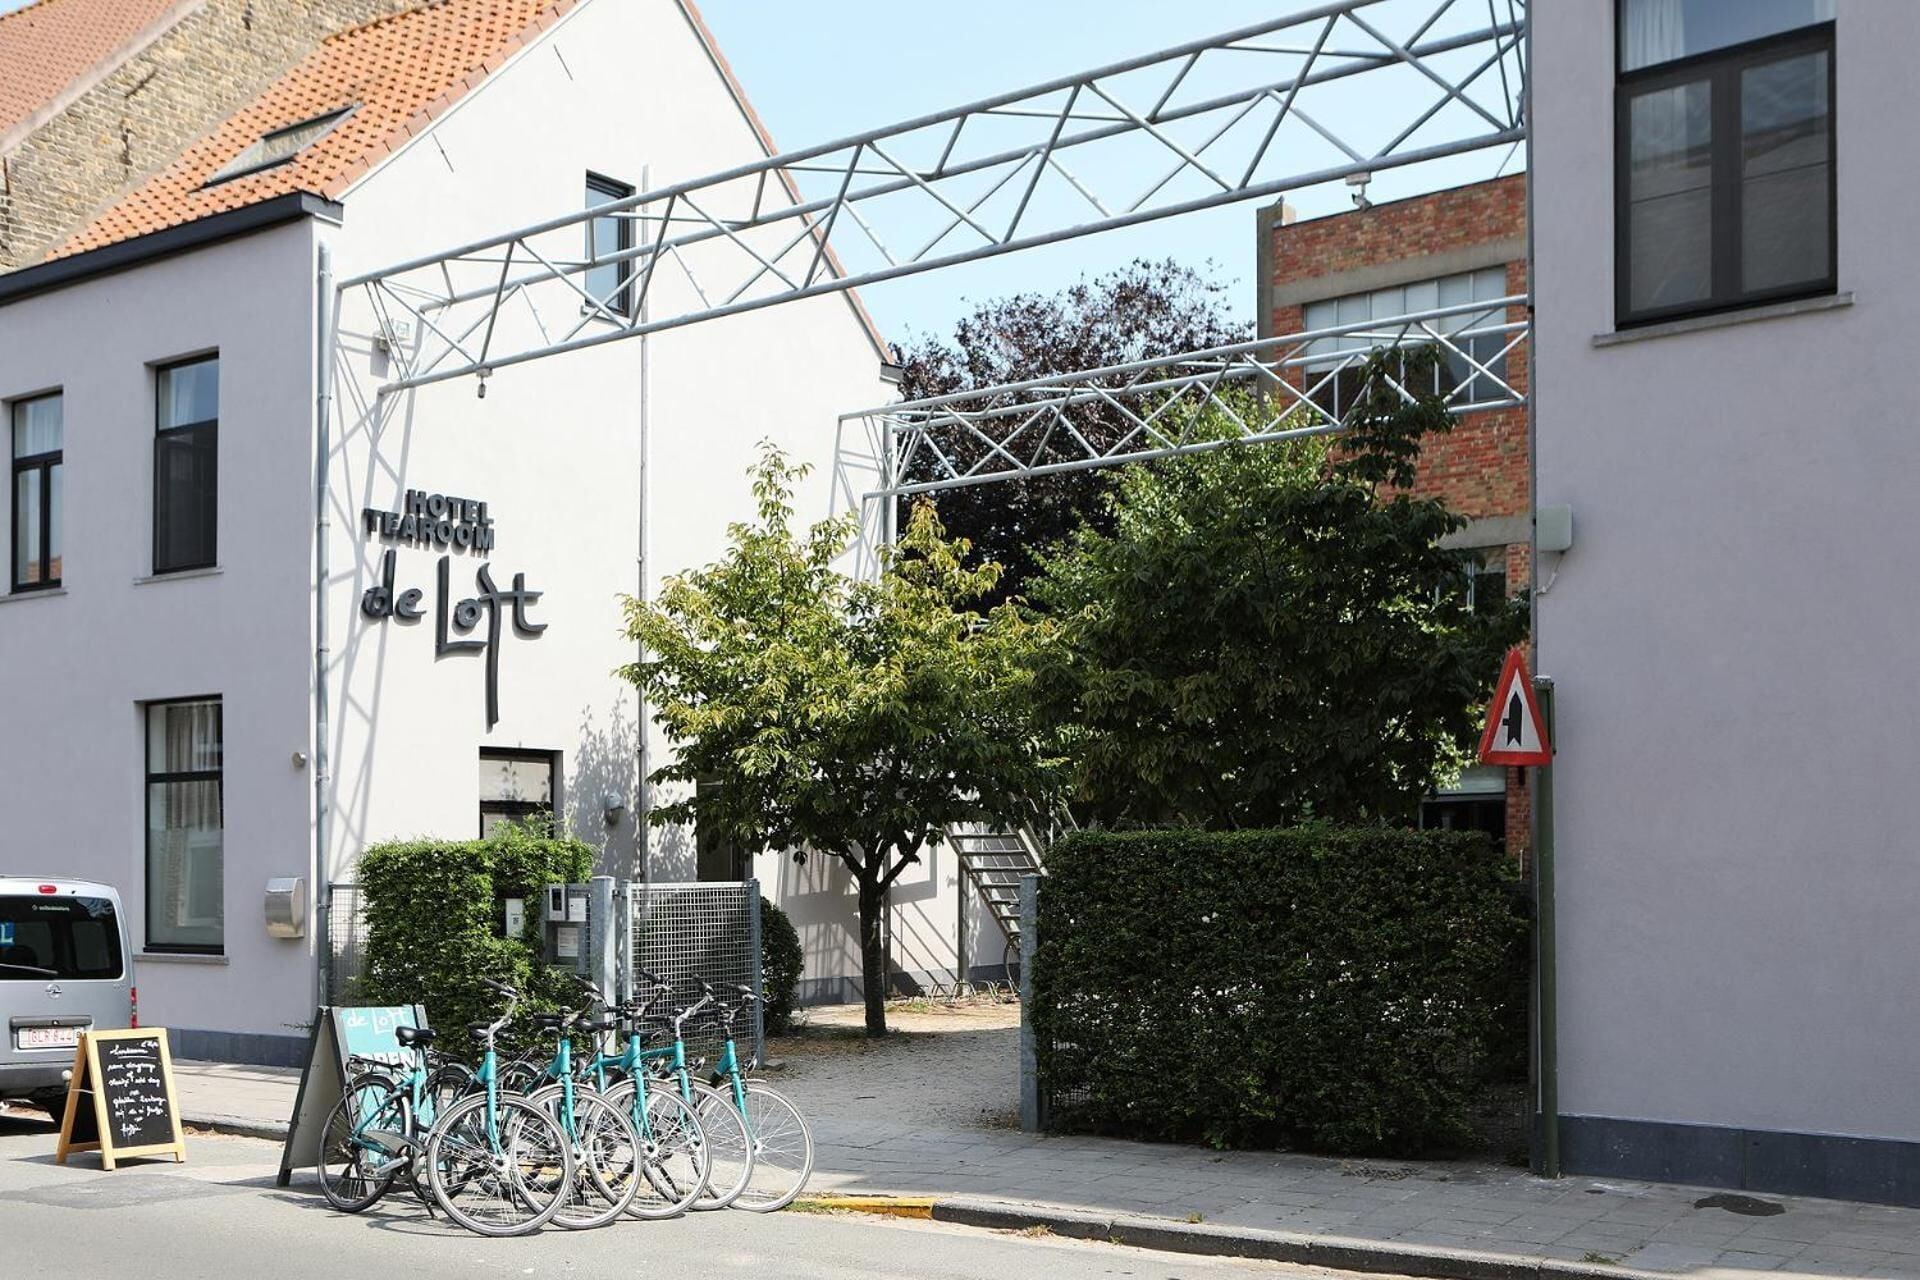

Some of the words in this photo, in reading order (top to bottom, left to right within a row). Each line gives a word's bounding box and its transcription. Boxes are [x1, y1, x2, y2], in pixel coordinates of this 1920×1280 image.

[406, 489, 494, 524] HOTEL
[363, 508, 495, 553] TEAROOM
[361, 549, 427, 622] de
[435, 555, 549, 734] Loft
[345, 1008, 368, 1027] de
